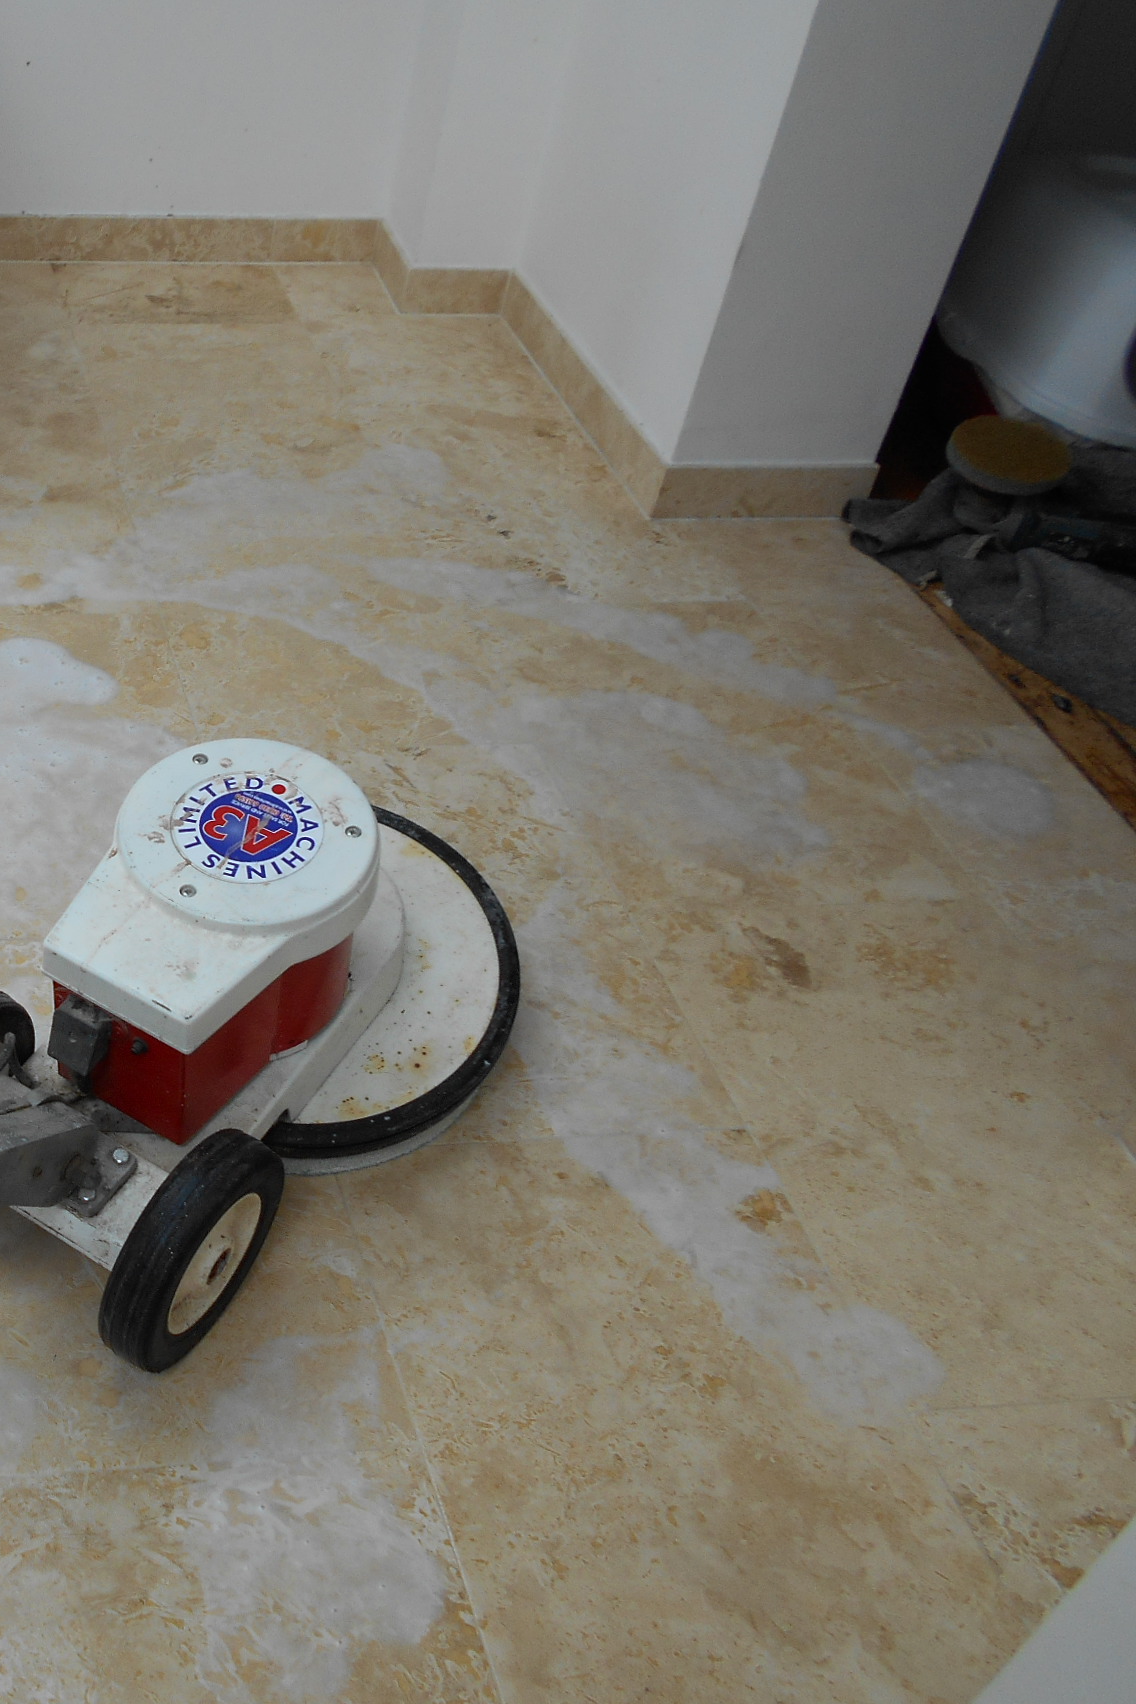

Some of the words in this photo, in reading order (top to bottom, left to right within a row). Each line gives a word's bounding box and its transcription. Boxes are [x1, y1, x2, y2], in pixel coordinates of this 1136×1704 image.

[178, 777, 264, 849] LIMITED
[202, 796, 319, 880] MACHINES
[203, 805, 294, 855] A3
